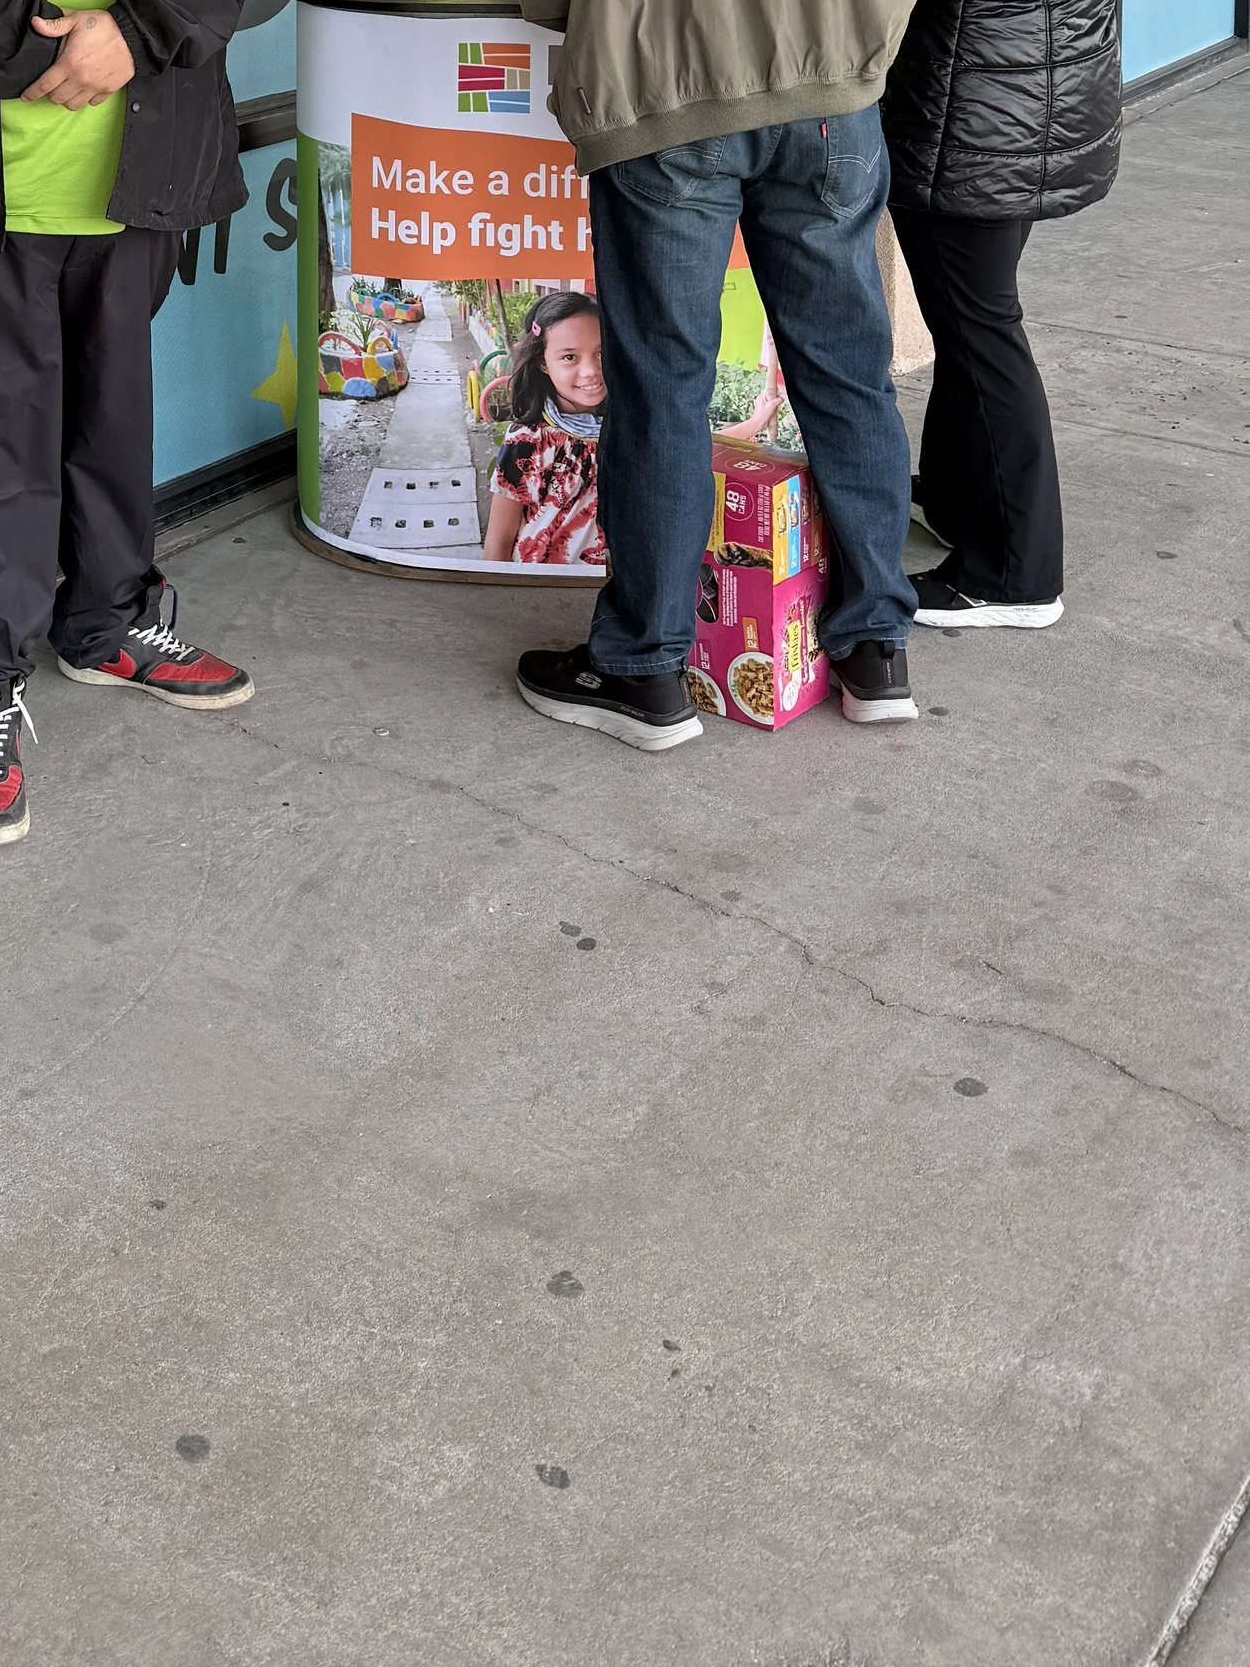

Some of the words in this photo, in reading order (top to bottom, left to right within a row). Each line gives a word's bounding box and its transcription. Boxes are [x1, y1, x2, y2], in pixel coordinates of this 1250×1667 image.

[371, 156, 475, 195] Make
[487, 170, 510, 196] a
[370, 207, 457, 255] Help
[467, 211, 564, 257] fight
[725, 490, 740, 513] 48
[738, 494, 747, 515] CANS
